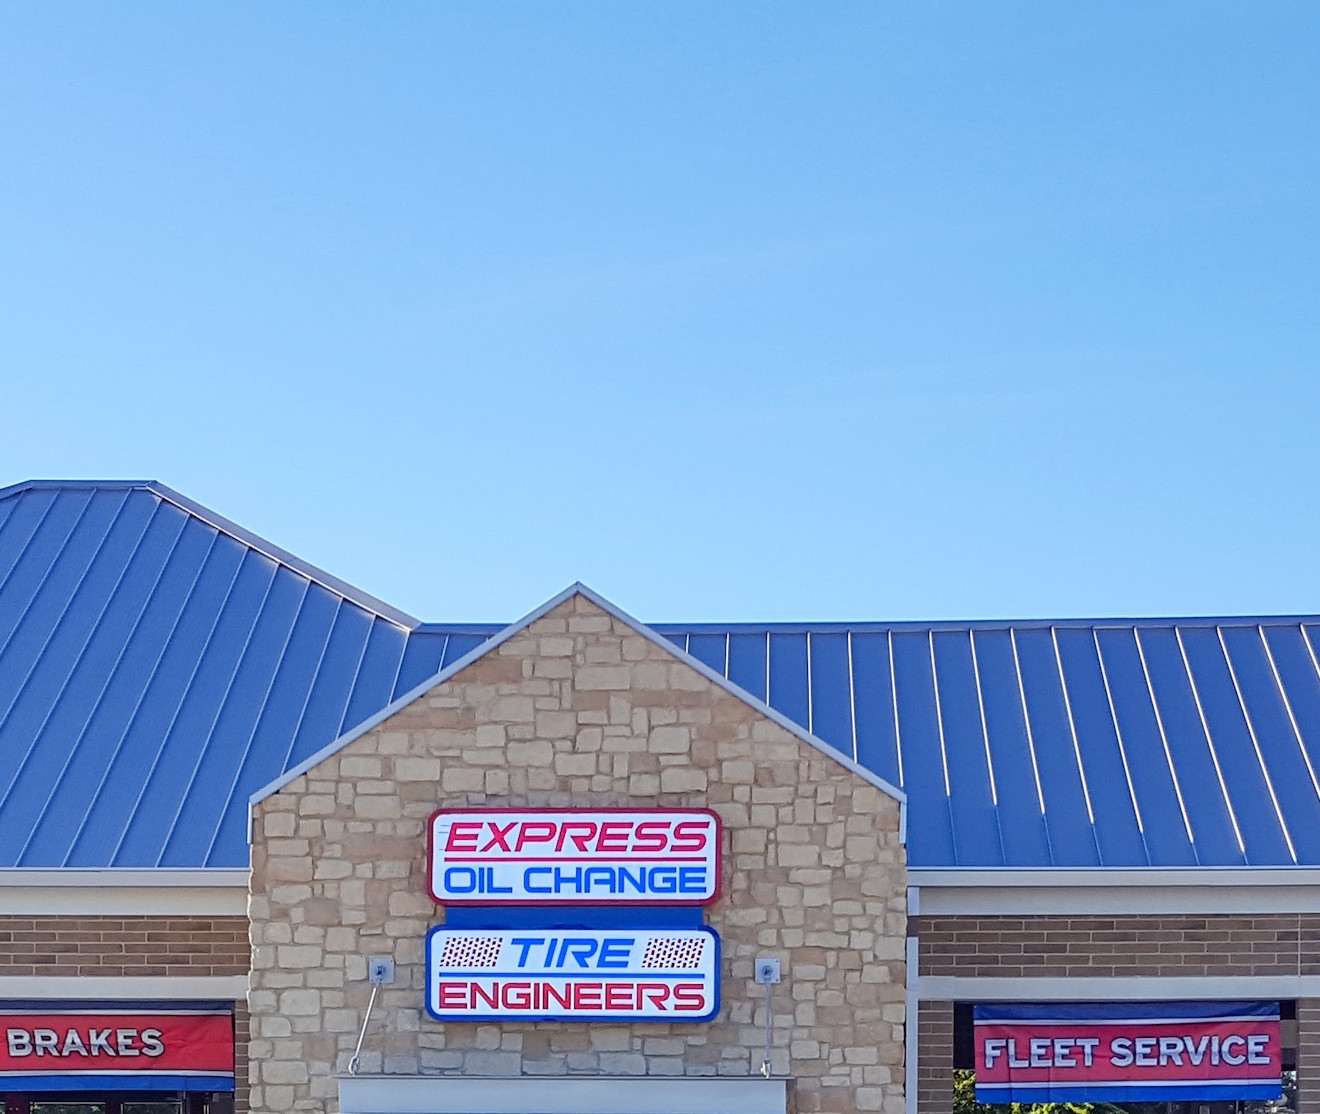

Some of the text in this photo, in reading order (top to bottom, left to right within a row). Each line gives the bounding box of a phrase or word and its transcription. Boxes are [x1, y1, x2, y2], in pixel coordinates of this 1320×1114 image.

[444, 821, 711, 852] EXPRESS
[443, 866, 707, 894] OIL CHANGE
[510, 938, 636, 968] TIRE
[438, 982, 705, 1011] ENGINEERS
[6, 1028, 166, 1058] BRAKES
[984, 1034, 1271, 1069] FLEET SERVICE
